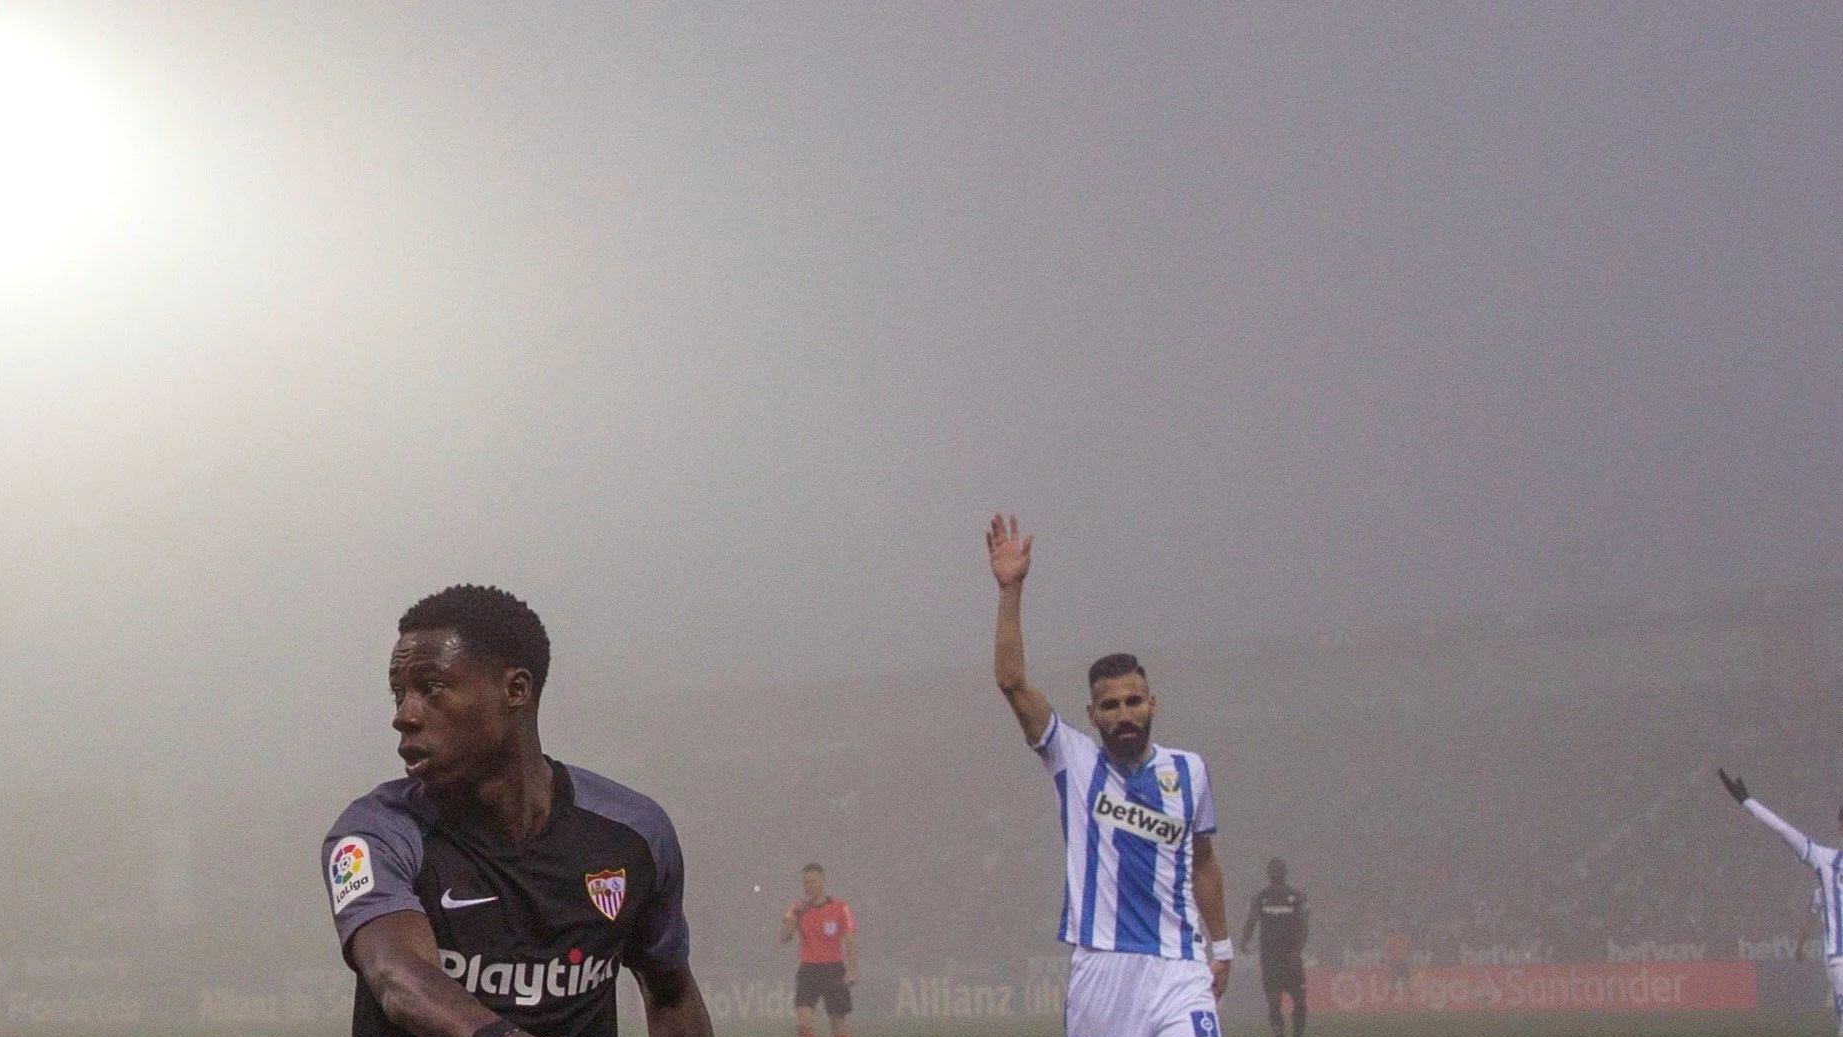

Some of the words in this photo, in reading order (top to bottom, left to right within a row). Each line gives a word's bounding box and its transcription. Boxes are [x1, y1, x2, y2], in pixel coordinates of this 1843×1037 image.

[1097, 795, 1183, 844] betway
[336, 874, 370, 904] LaLiga
[894, 976, 1014, 1017] Allianz
[1506, 966, 1686, 1005] Santander
